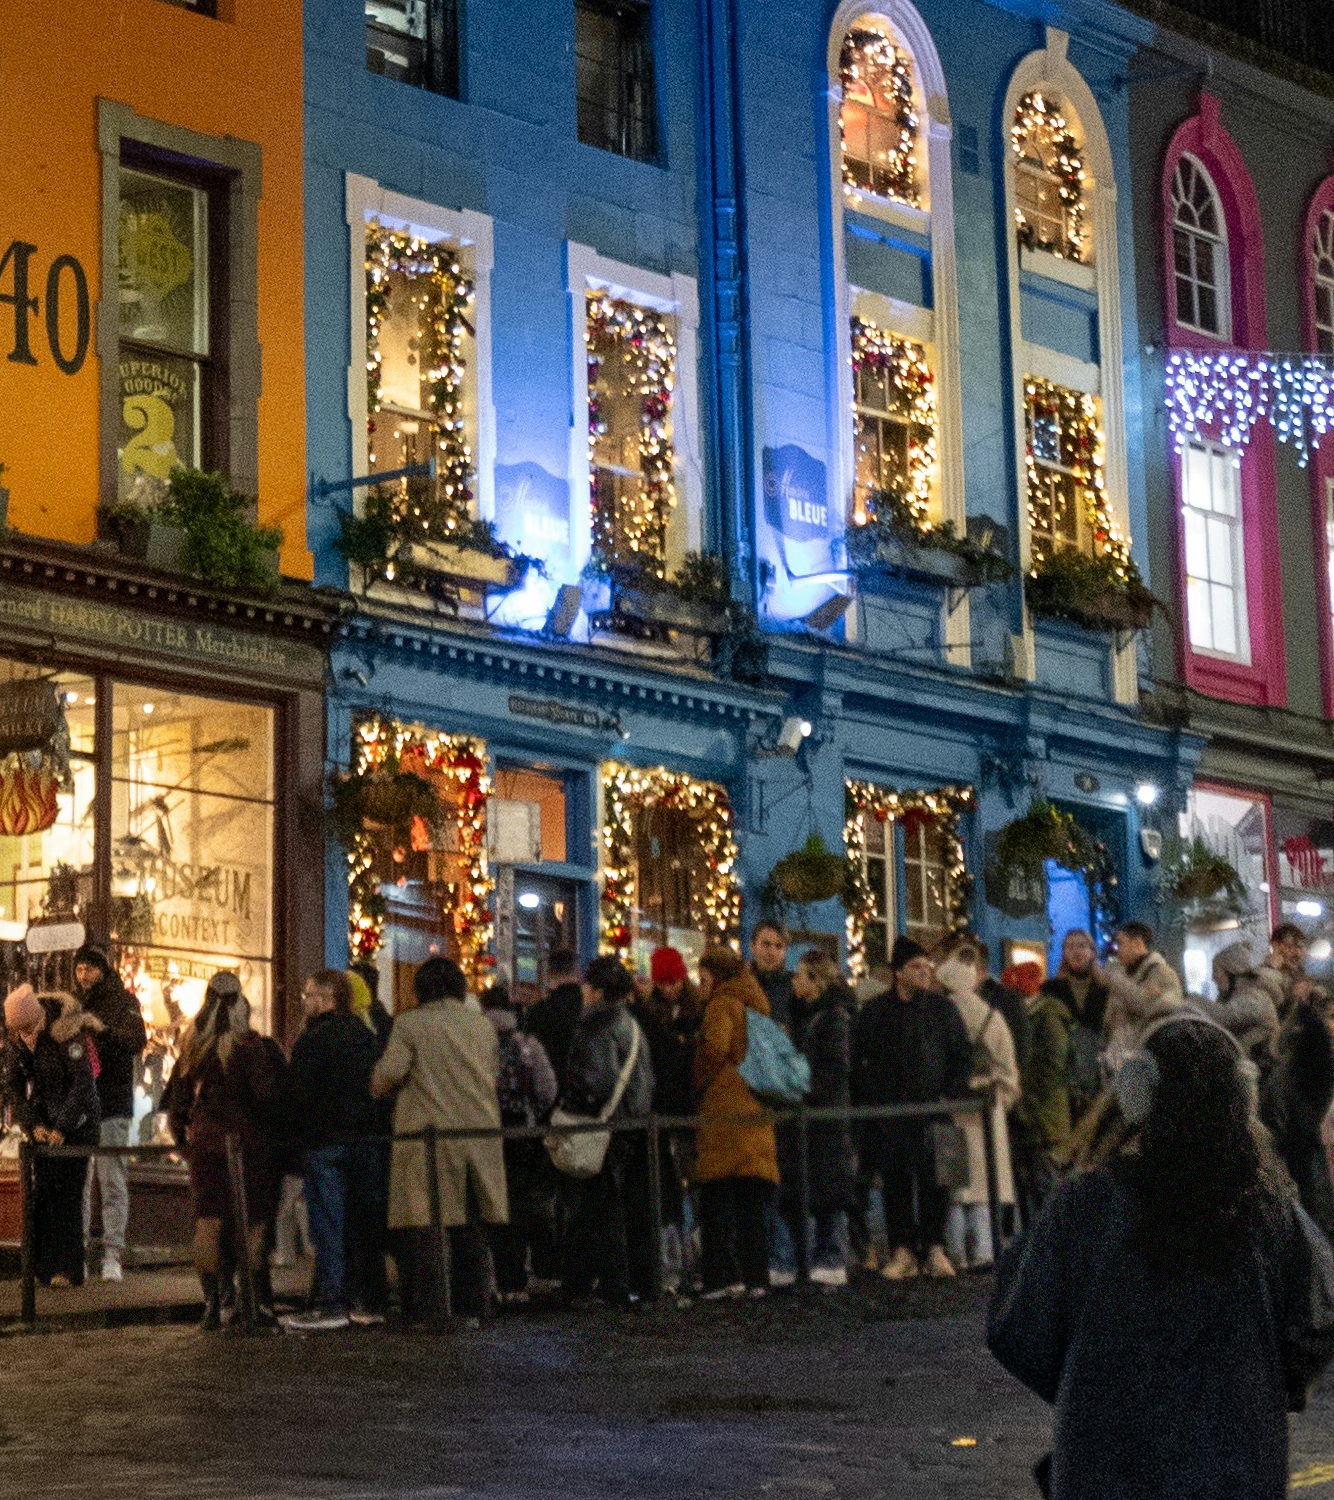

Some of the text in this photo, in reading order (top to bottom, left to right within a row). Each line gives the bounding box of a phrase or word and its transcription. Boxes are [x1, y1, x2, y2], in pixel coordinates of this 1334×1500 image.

[119, 360, 187, 395] UPERIOR
[788, 497, 828, 528] BLEUE
[49, 602, 114, 634] HARRY
[116, 611, 189, 650] POTTER
[157, 912, 231, 946] CONTEXT
